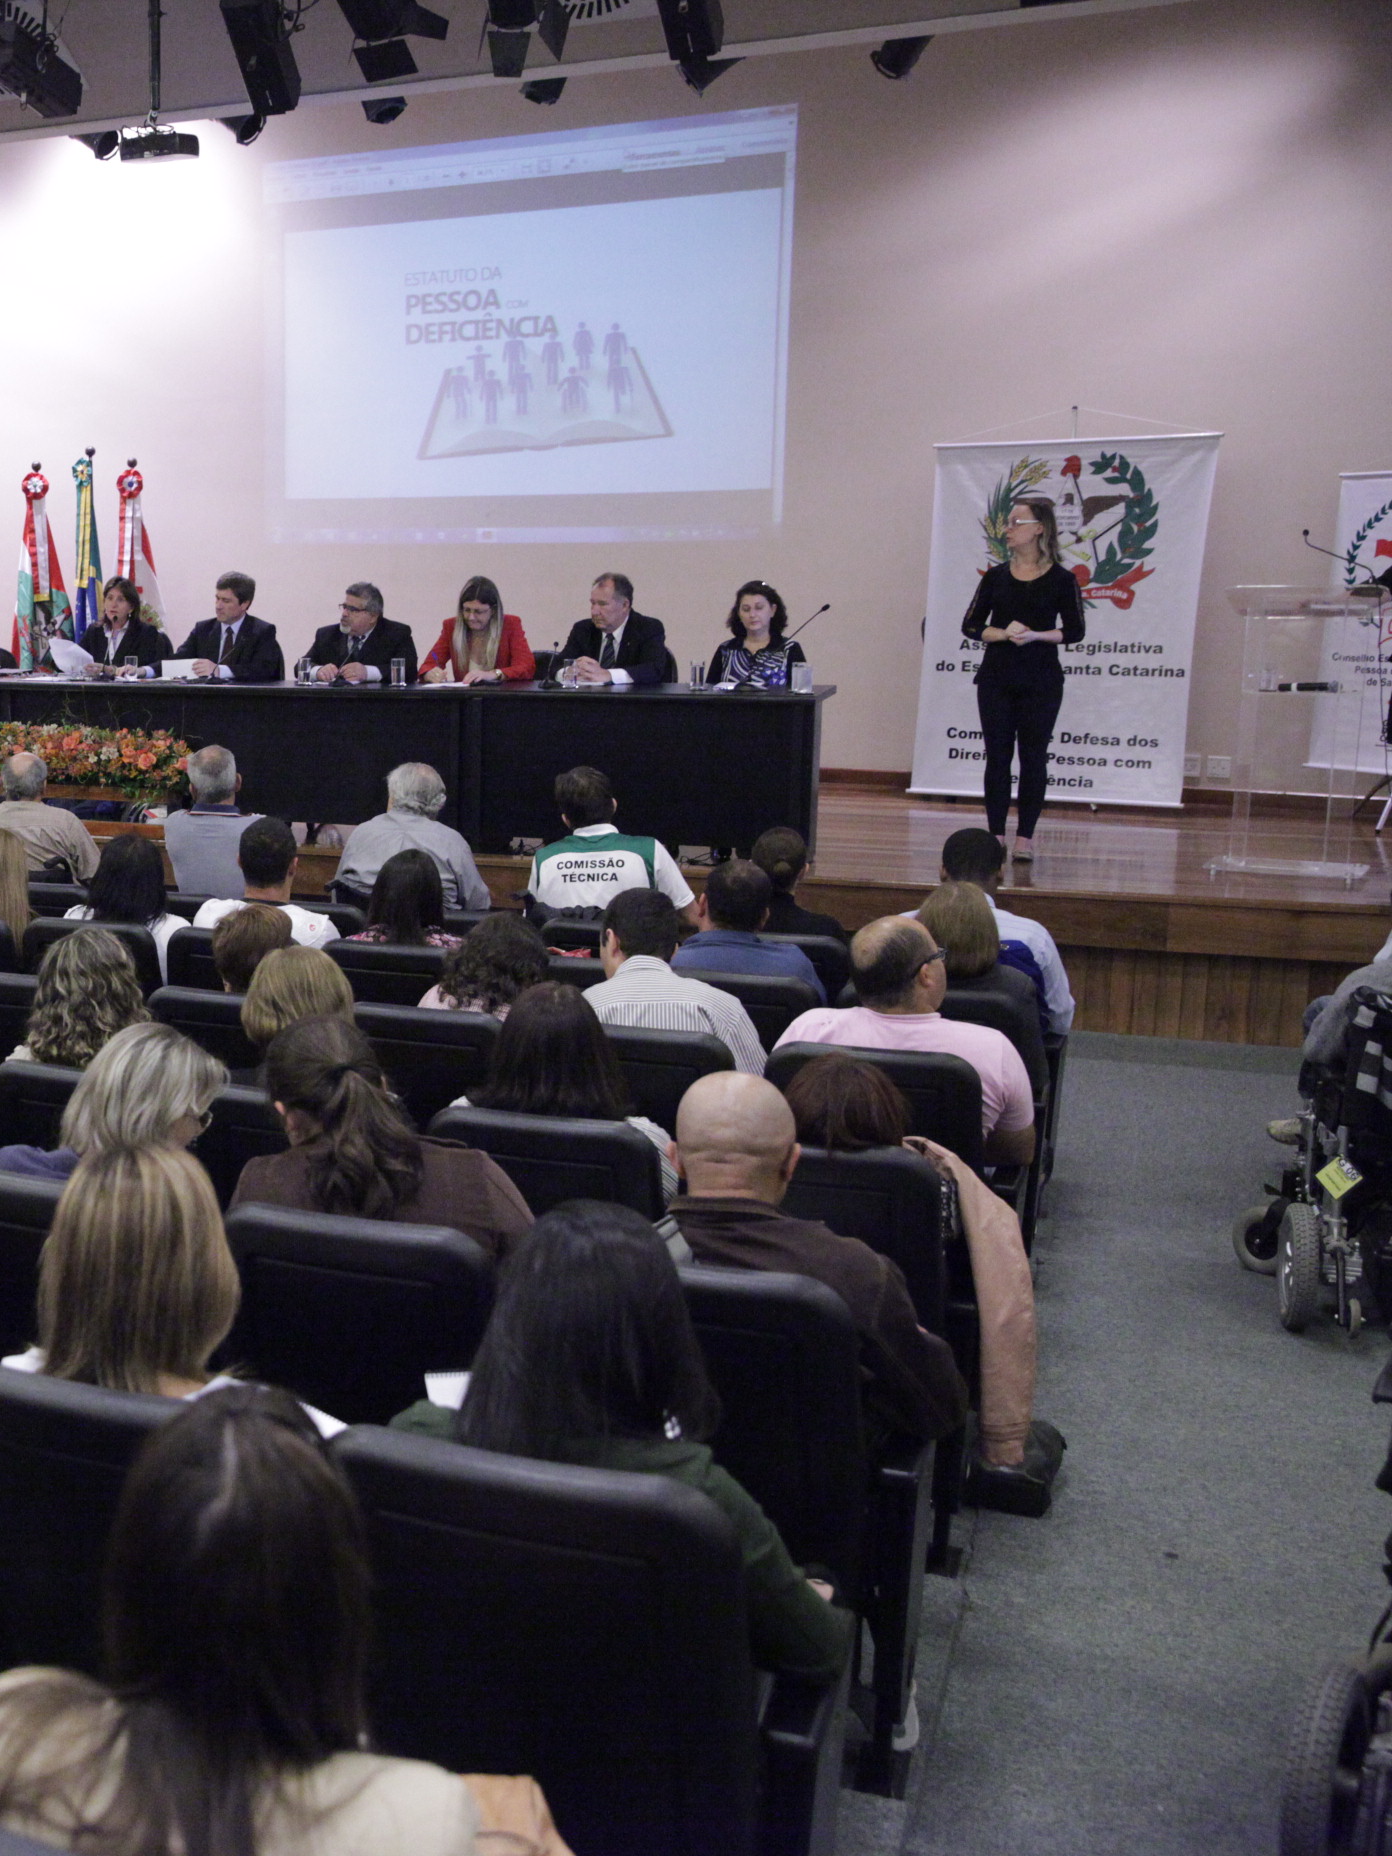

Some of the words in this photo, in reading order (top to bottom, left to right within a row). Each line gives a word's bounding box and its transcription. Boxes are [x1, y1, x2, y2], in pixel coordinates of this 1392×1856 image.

[404, 267, 477, 287] ESTATUTO
[480, 266, 502, 281] DA
[405, 288, 501, 316] PESSOA
[405, 312, 559, 345] DEFICIÊNCIA
[1064, 641, 1164, 656] Legislativa
[935, 660, 955, 672] do
[1062, 664, 1102, 675] anta
[1108, 664, 1186, 678] Catarina
[1366, 677, 1378, 686] de
[1060, 732, 1121, 746] Defesa
[1127, 735, 1159, 748] dos
[948, 747, 988, 761] Direi
[1047, 752, 1107, 767] Pessoa
[1113, 758, 1152, 769] com
[556, 857, 625, 871] COMISSÃO
[561, 872, 619, 883] TÉCNICA
